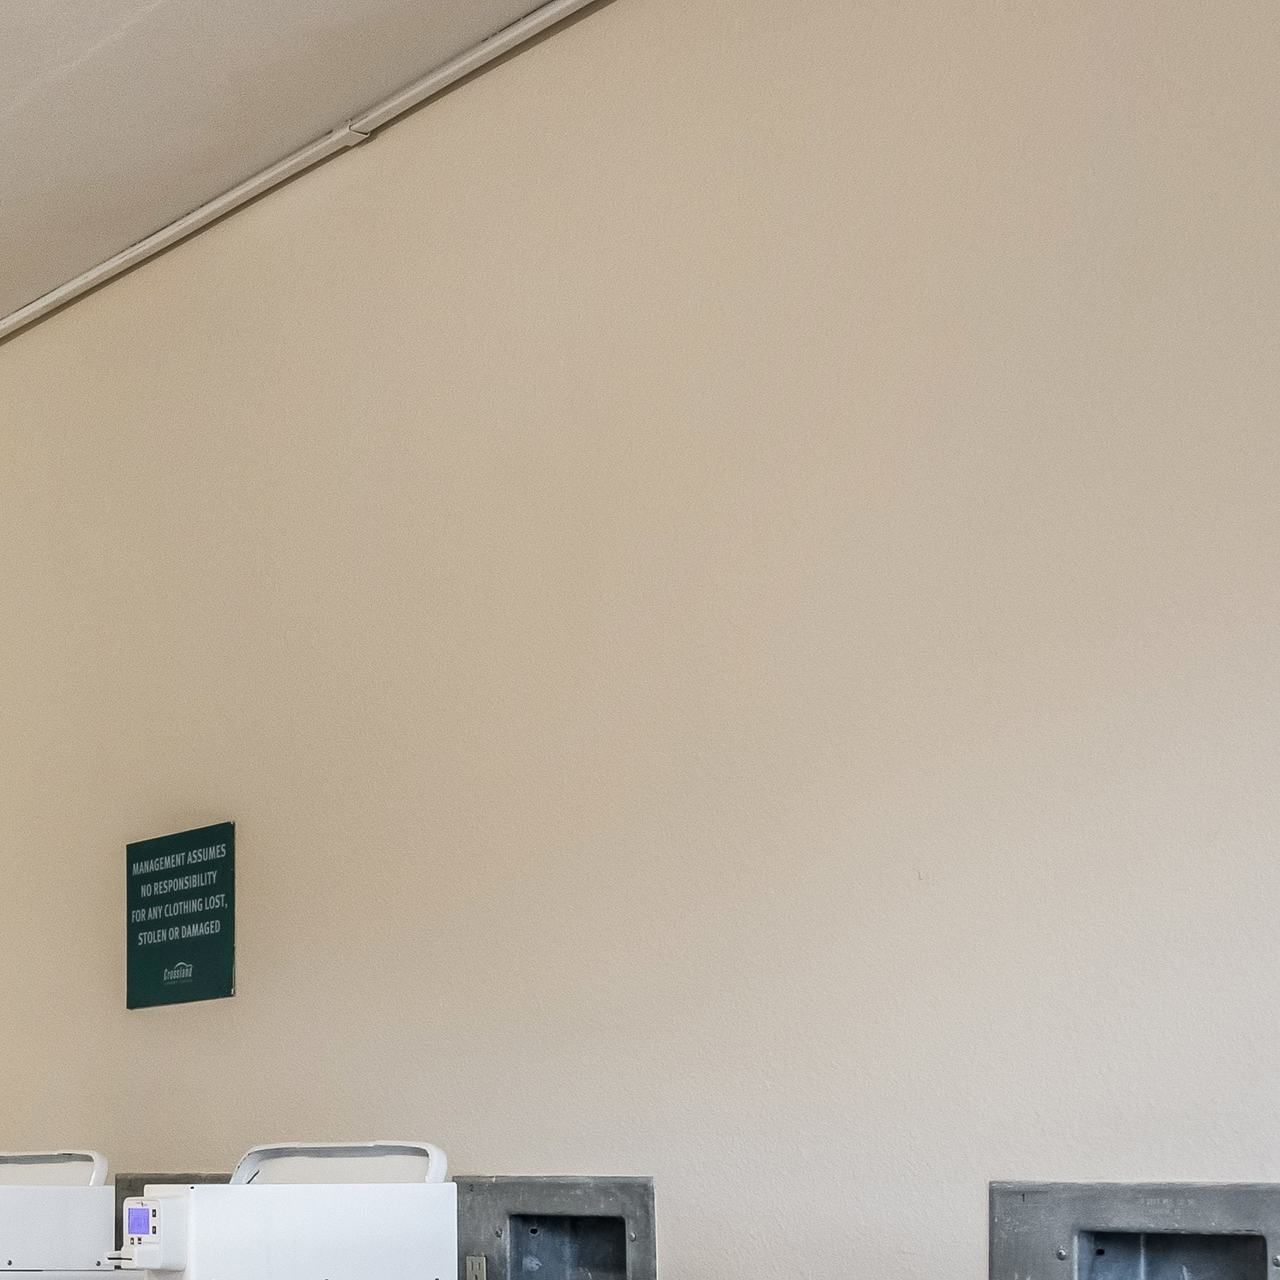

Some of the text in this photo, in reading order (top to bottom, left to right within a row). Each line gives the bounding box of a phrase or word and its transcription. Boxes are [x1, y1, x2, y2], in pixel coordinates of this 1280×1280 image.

[132, 843, 227, 875] MANAGEMENT ASSUMES
[141, 870, 218, 897] NO RESPONSIBILITY
[132, 894, 228, 923] FOR ANY CLOTHING LOST,
[138, 919, 221, 946] STOLEN OR DAMAGED
